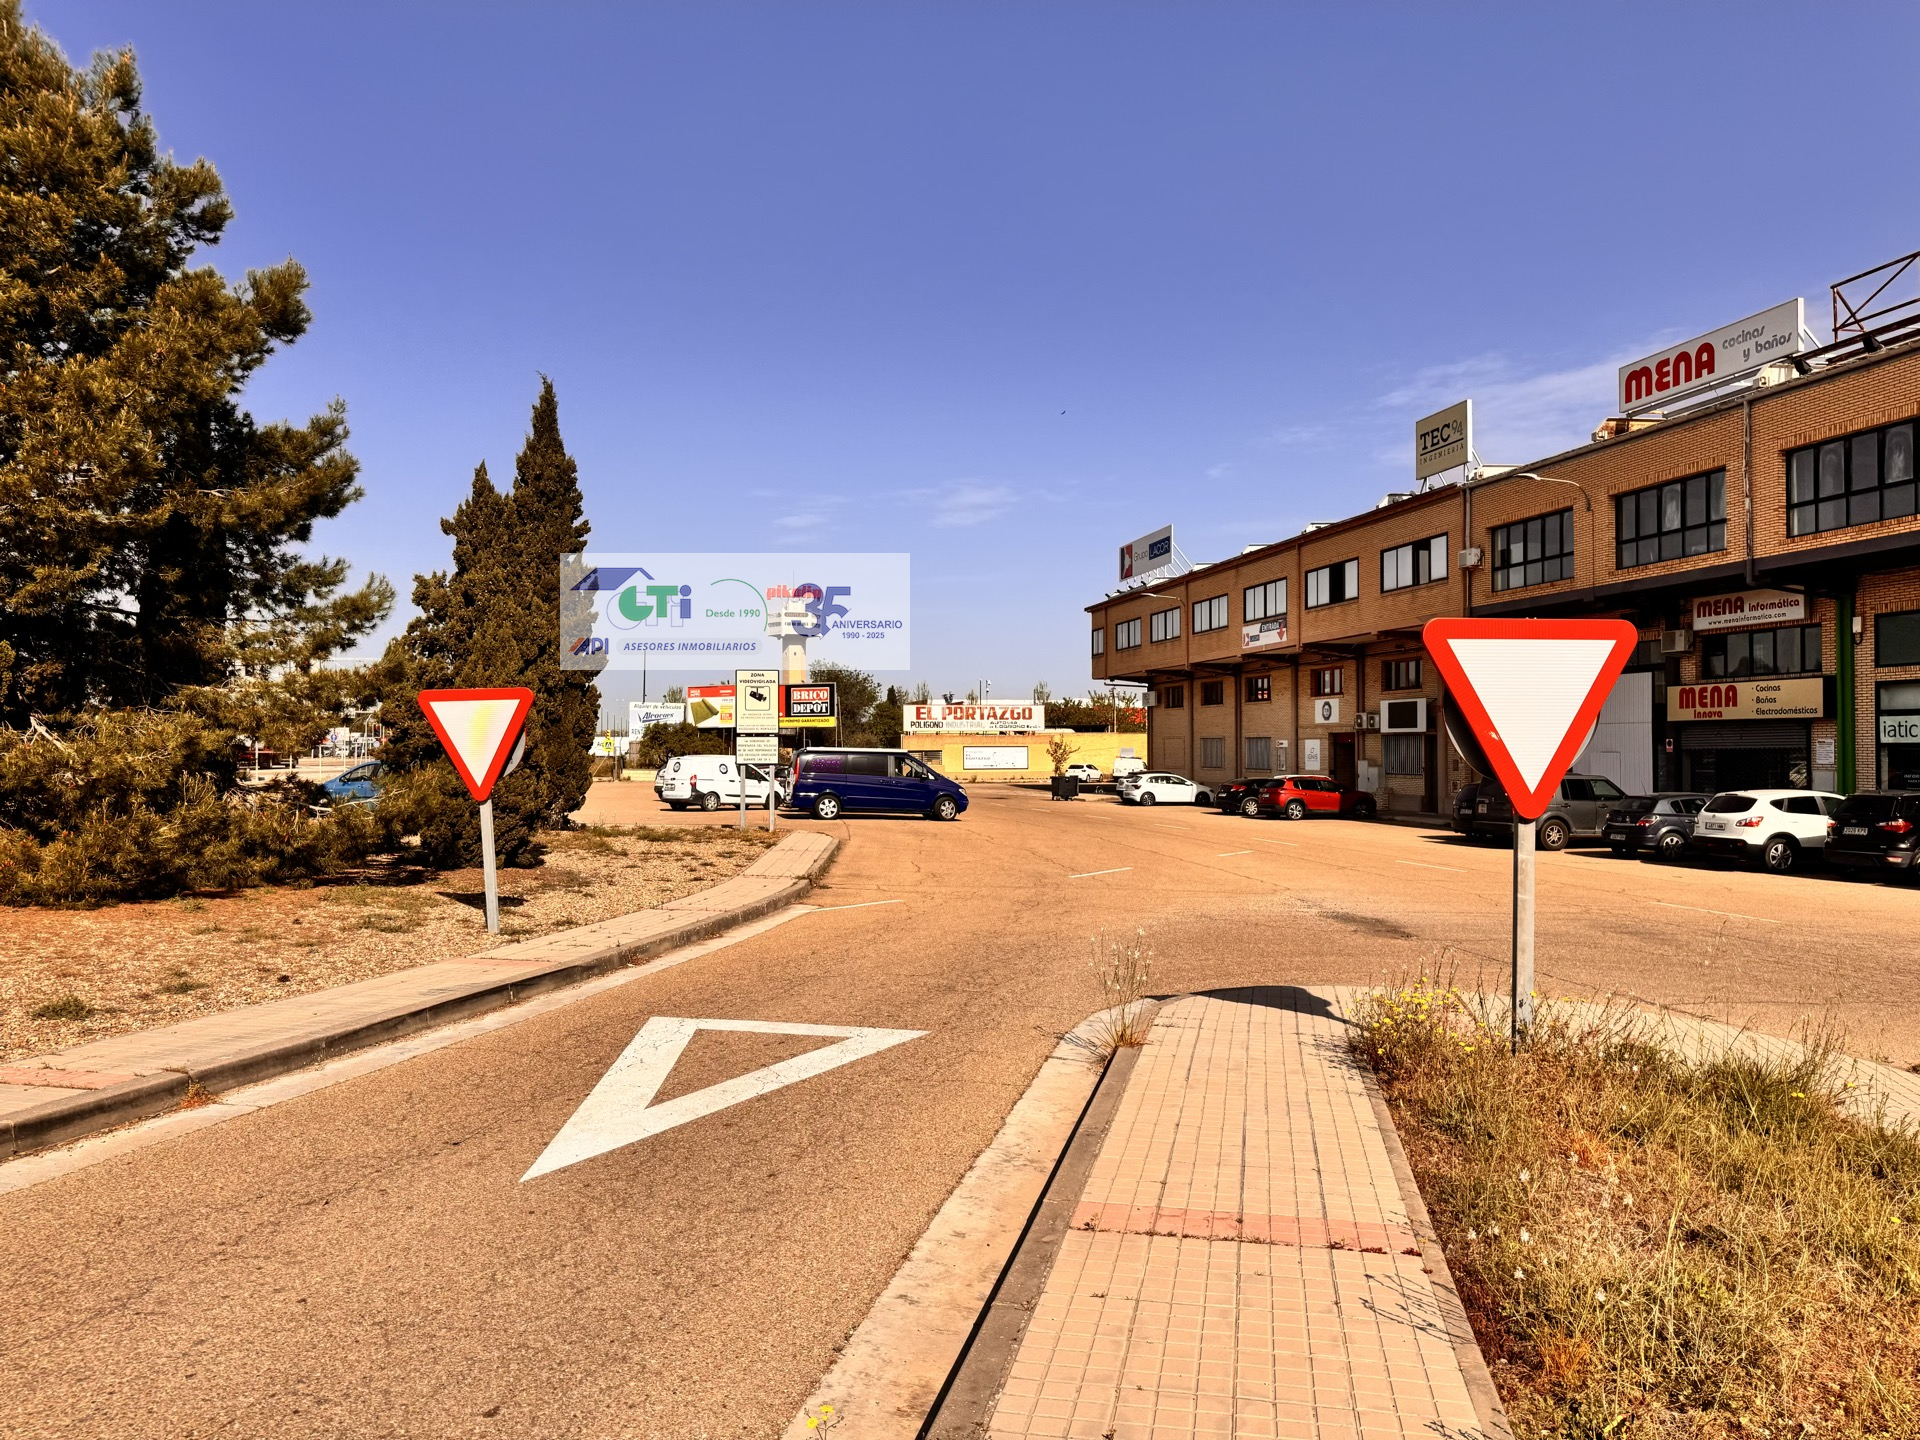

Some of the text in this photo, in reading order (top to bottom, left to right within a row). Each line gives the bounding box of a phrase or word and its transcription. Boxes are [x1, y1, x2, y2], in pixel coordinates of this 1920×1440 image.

[1722, 325, 1765, 349] cocinas
[1743, 332, 1792, 362] y baños
[1625, 342, 1715, 404] MENA
[1134, 550, 1148, 561] Grupo
[1697, 596, 1800, 618] MENA Informática
[1708, 612, 1787, 625] www.menainformatica.com
[793, 690, 828, 700] BRICO
[1755, 684, 1781, 693] Cocinas
[1679, 685, 1738, 709] MENA
[1755, 695, 1777, 704] Baños
[915, 706, 1033, 720] EL PORTAZGO
[1693, 709, 1723, 719] Innova
[1755, 706, 1818, 716] Electrodomésticos
[911, 720, 985, 729] POLIGONO INDUSTRIAL
[1883, 720, 1918, 738] iatic
